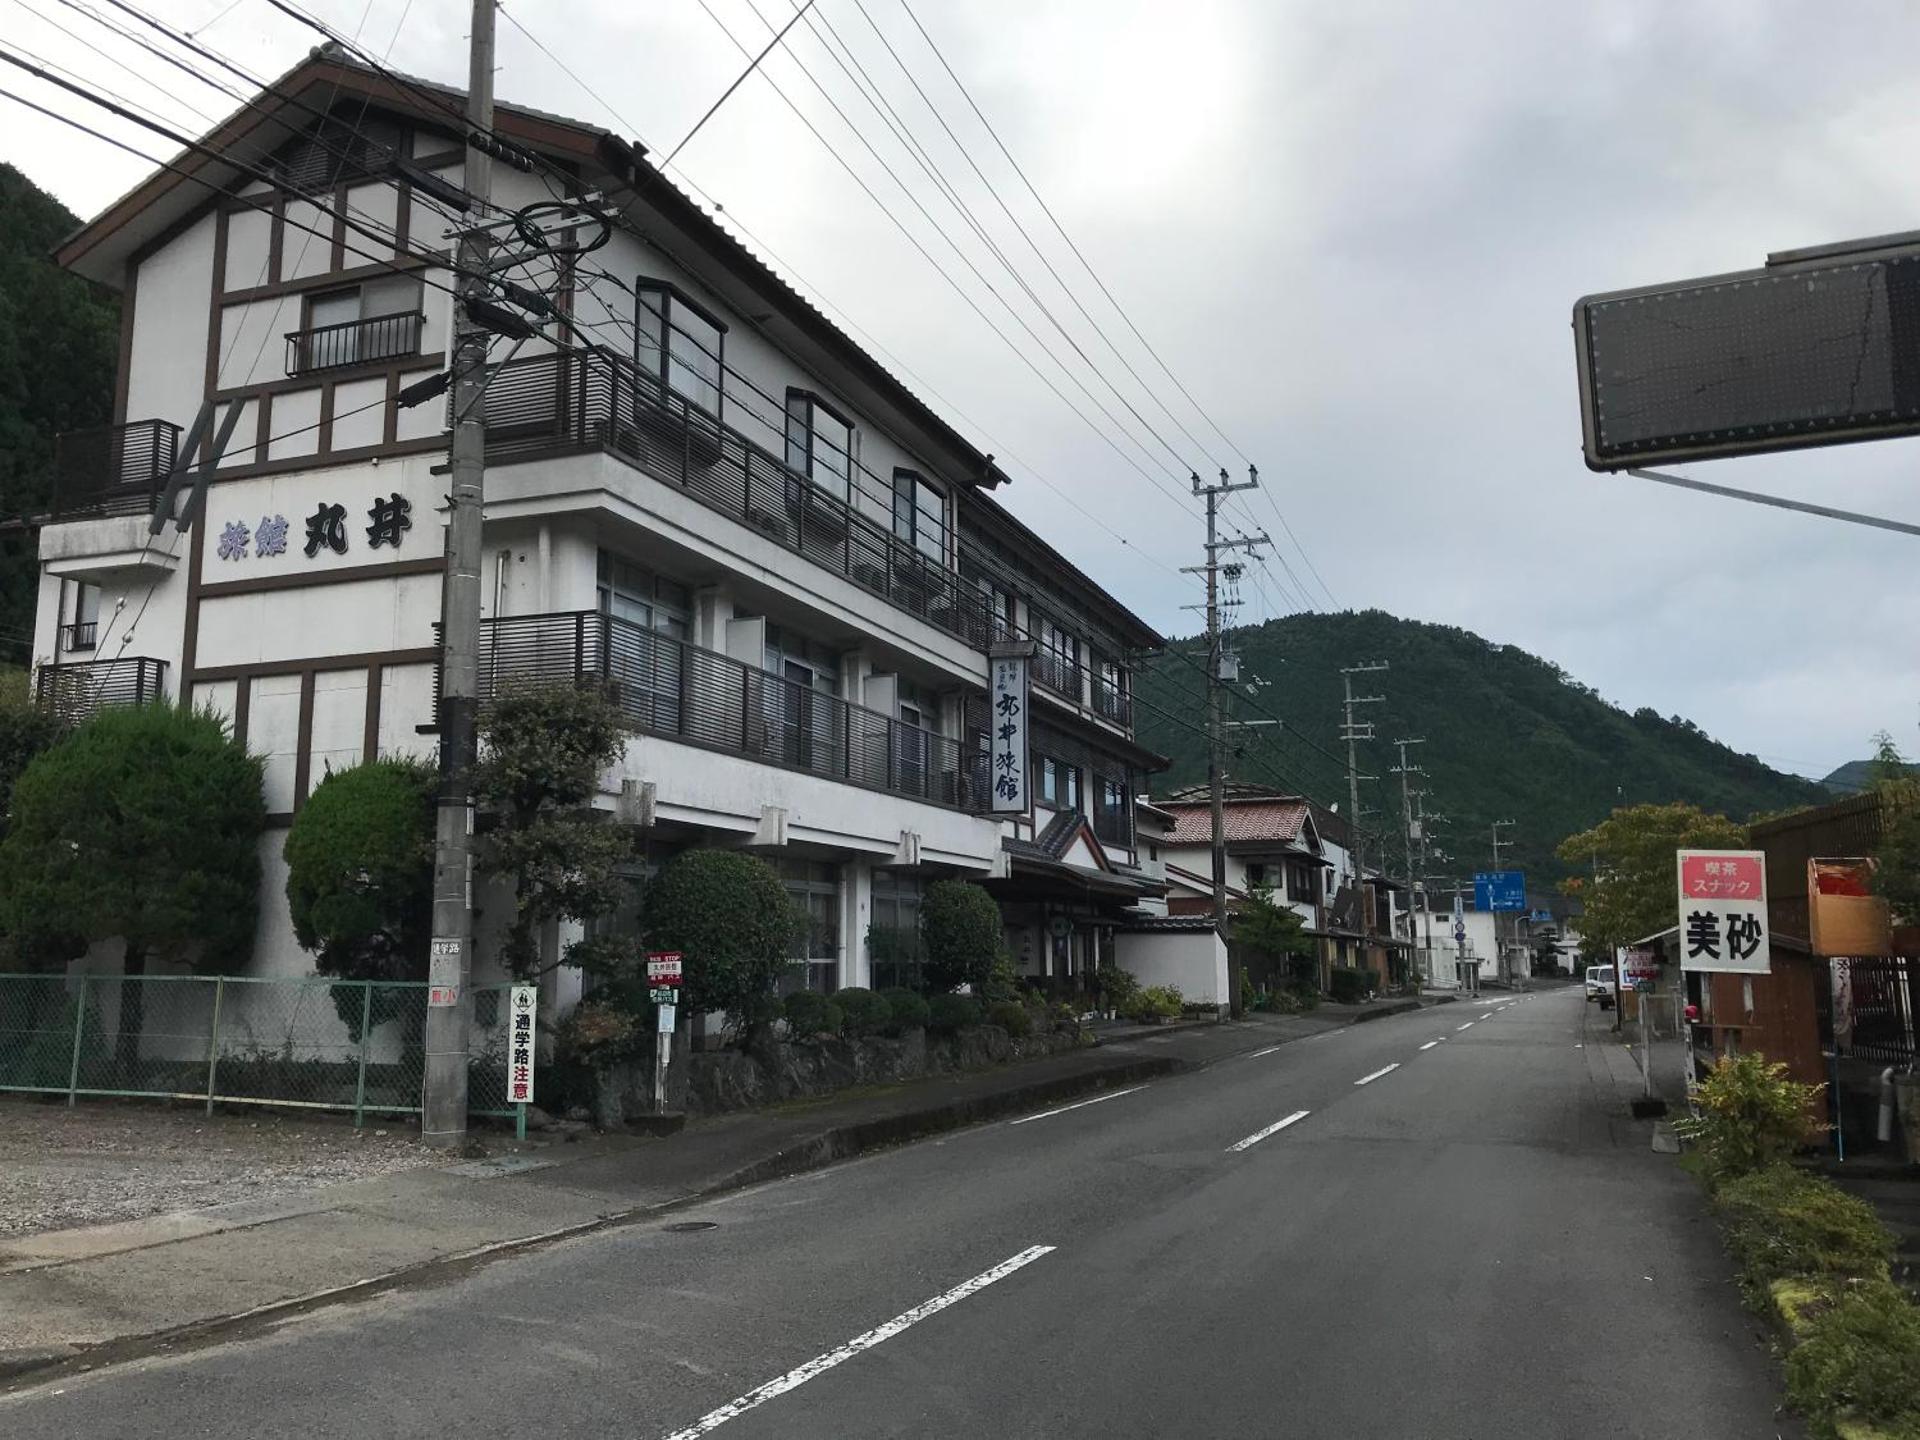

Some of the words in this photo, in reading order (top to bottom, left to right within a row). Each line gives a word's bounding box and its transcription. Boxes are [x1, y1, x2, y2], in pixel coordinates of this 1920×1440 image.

[304, 492, 412, 558] 丸井
[995, 693, 1020, 801] 丸井旅館
[1693, 879, 1750, 893] スナック
[1705, 862, 1737, 876] 喫茶
[1687, 910, 1762, 960] 美砂
[513, 1014, 530, 1099] 通学路注意
